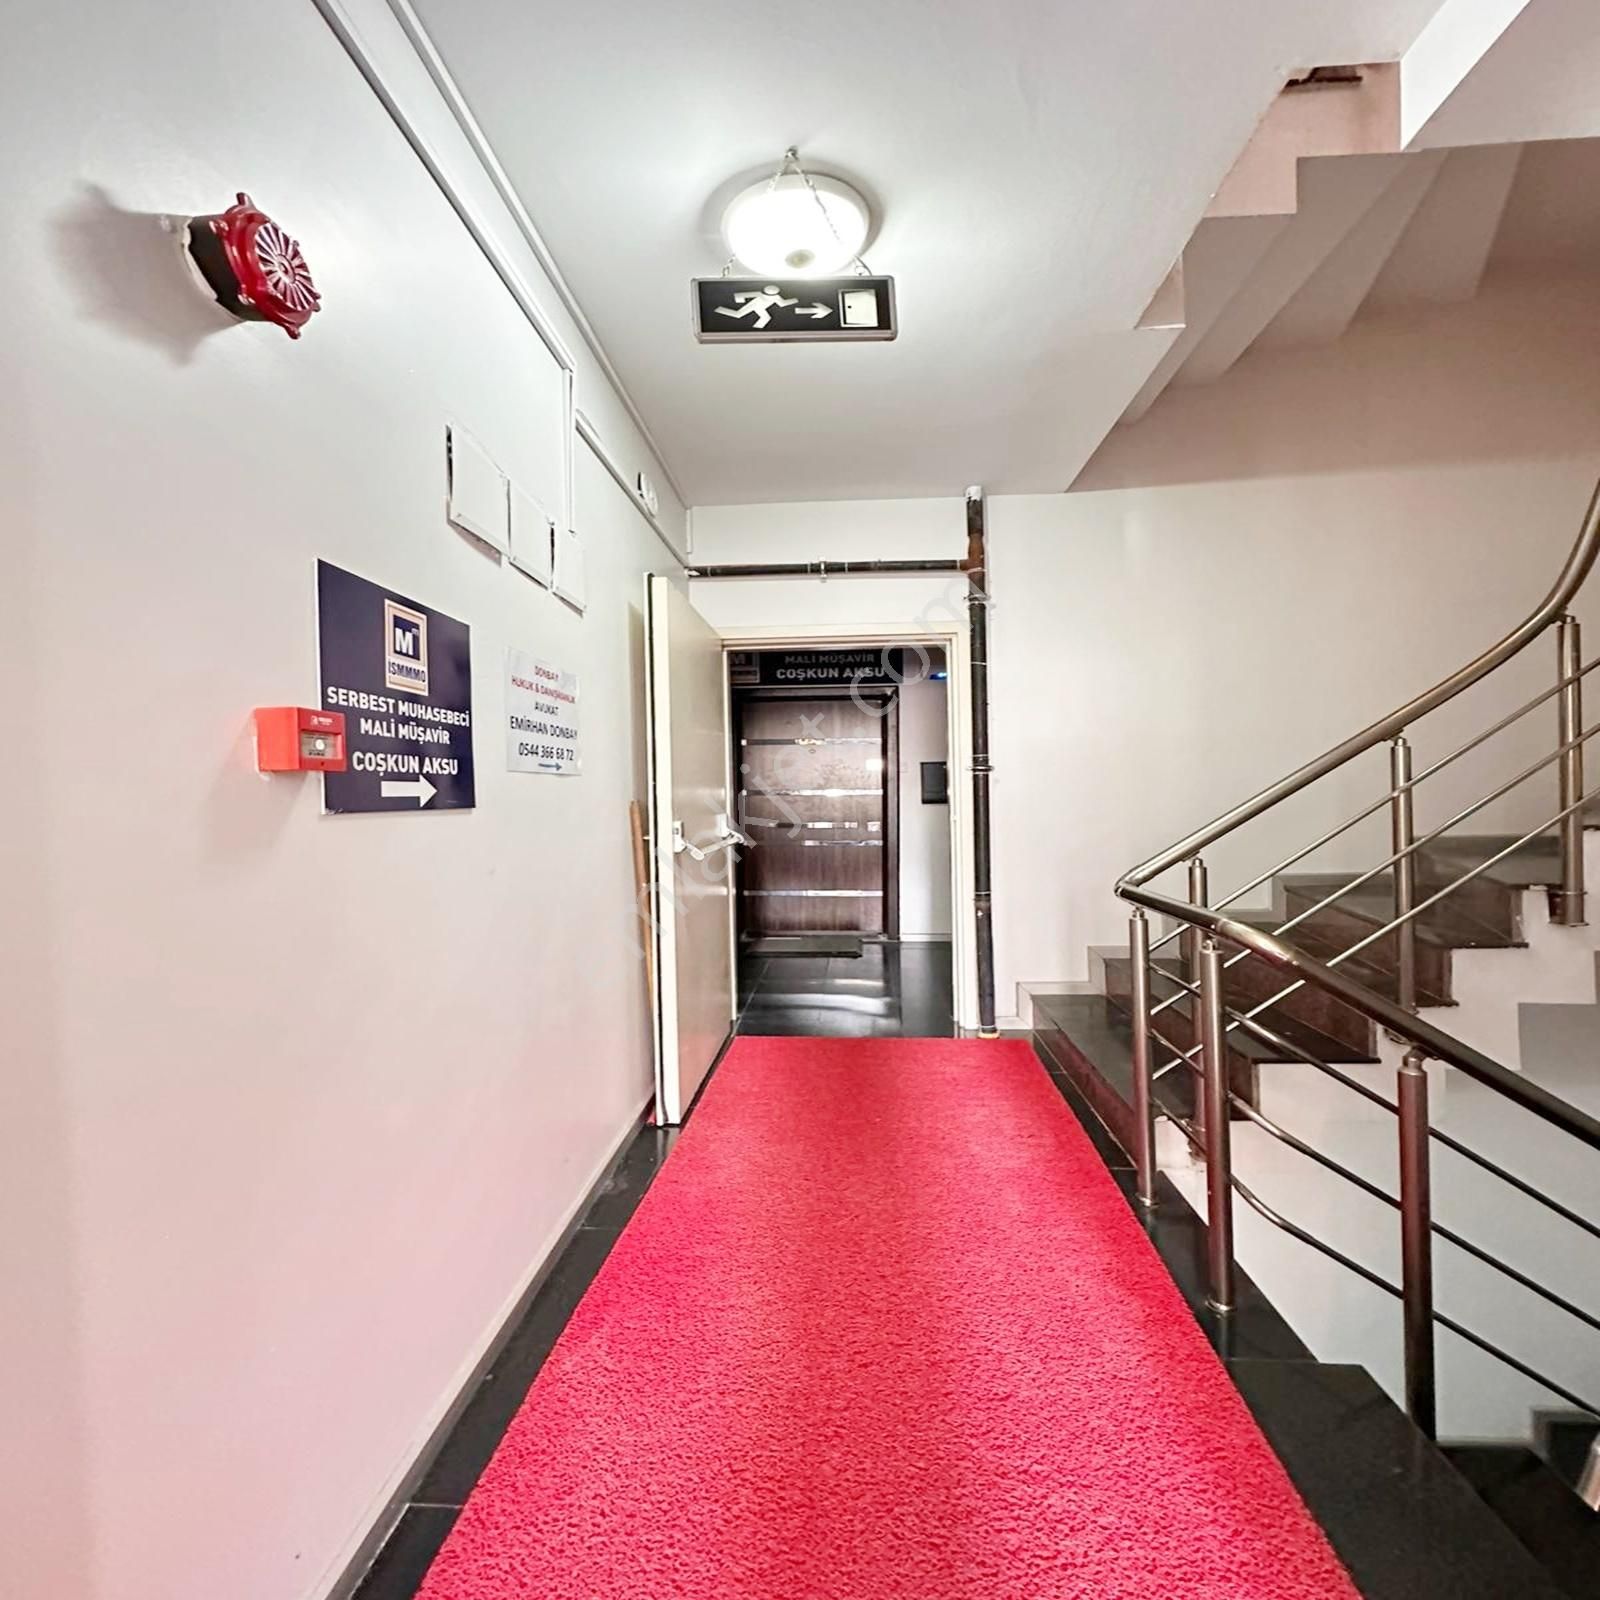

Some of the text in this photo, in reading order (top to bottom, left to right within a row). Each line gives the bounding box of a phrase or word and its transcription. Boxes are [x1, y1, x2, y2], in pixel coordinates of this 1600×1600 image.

[534, 665, 559, 681] DONBAY
[776, 667, 885, 680] COŞKUN AKSU
[512, 675, 534, 691] HUKUK
[327, 686, 470, 728] SERBEST MUHASEBECİ
[534, 701, 560, 715] AVUKAT
[360, 717, 450, 745] MALİ MÜŞAVİR
[510, 715, 577, 740] EMİRHAN DONBAY
[518, 742, 574, 761] 0544 366 68 72
[352, 751, 458, 776] COŞKUN AKSU
